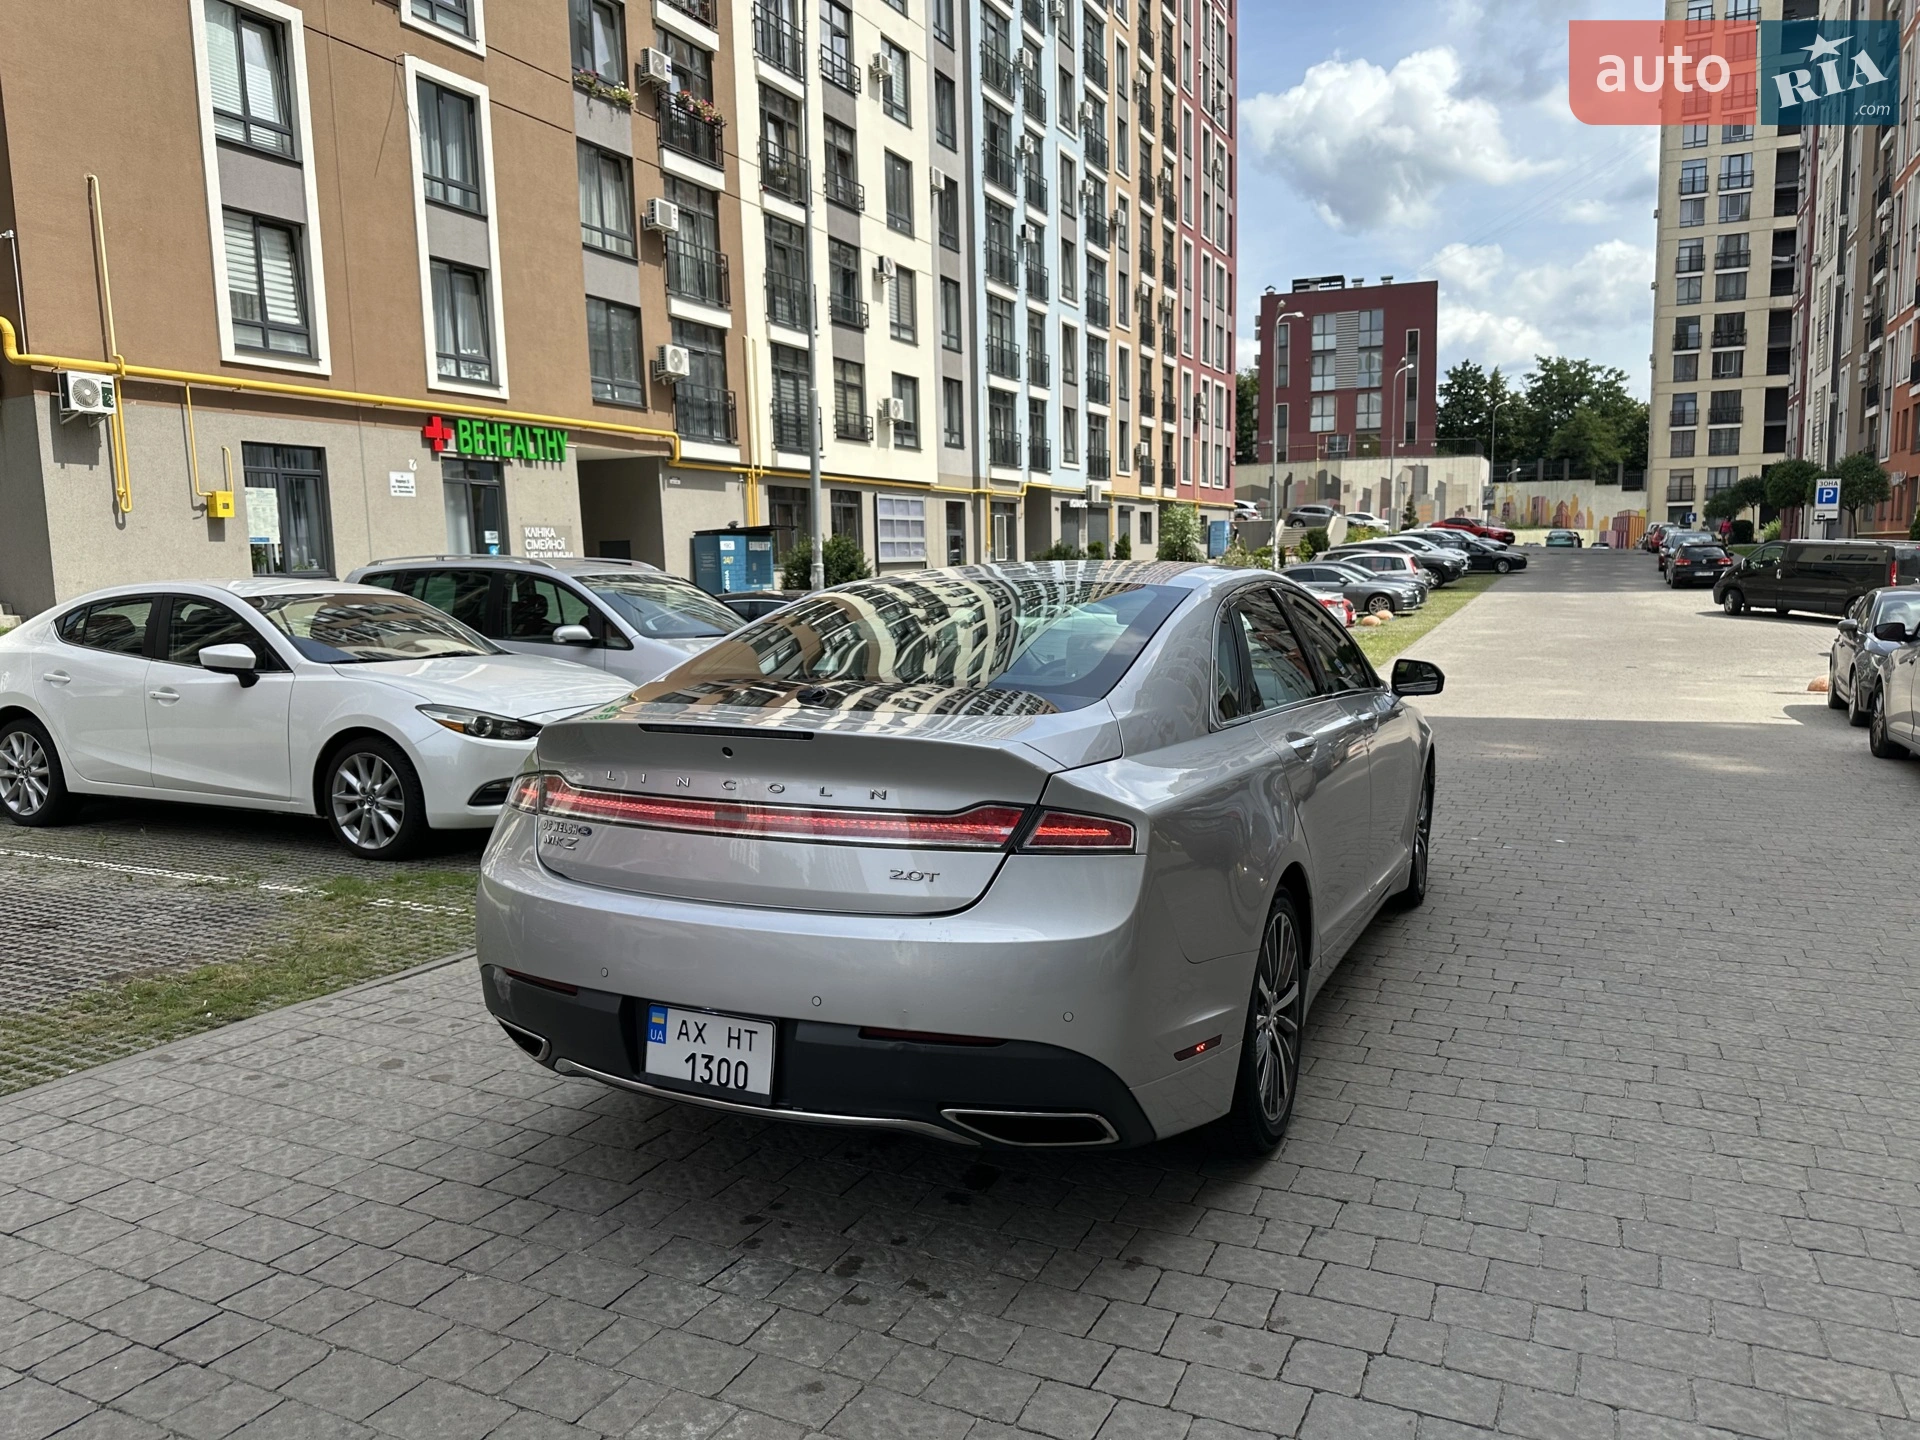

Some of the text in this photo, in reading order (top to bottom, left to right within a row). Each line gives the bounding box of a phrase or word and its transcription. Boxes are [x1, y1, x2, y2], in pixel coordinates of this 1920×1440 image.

[457, 418, 568, 462] BEHEALTHY
[1822, 489, 1834, 502] P
[524, 526, 556, 538] КЛІНІКА
[525, 537, 566, 550] СІМЕЙНОЇ
[606, 770, 887, 800] LINCOLN
[543, 834, 580, 851] MKZ
[650, 1029, 664, 1042] UA
[676, 1019, 759, 1052] AX HT
[684, 1052, 749, 1090] 1300
